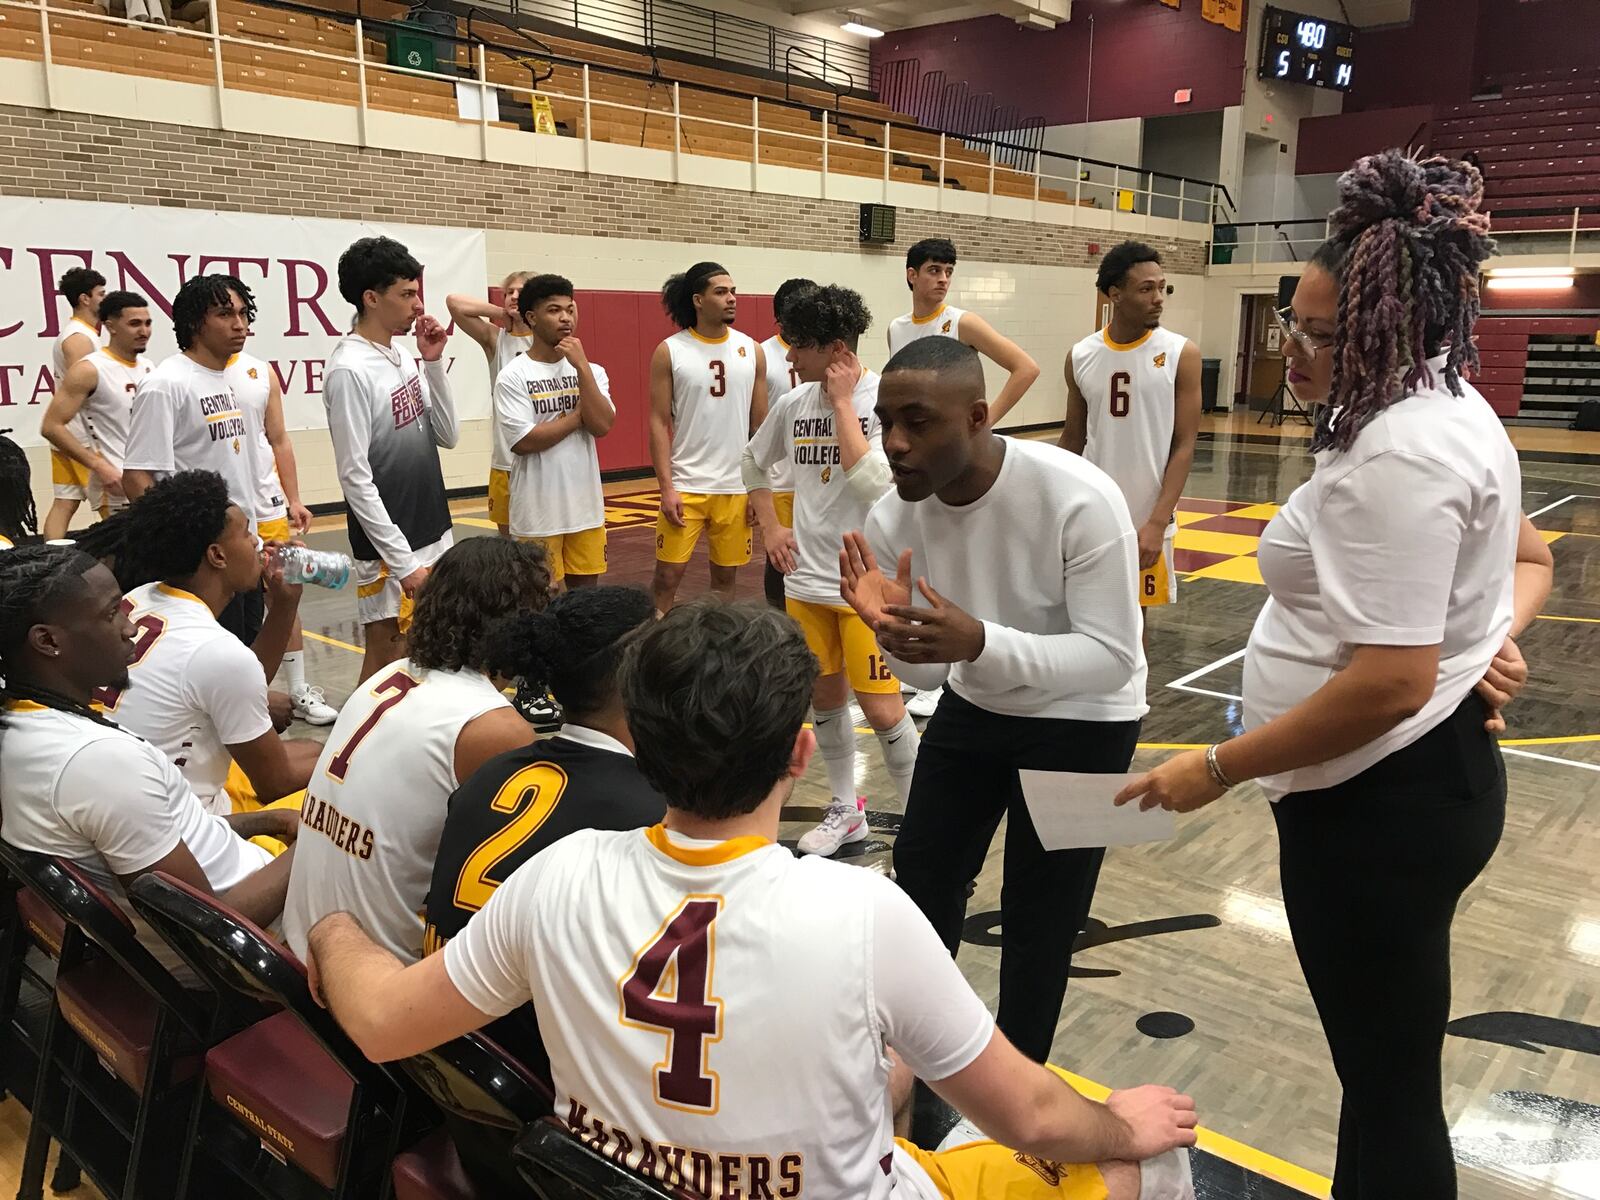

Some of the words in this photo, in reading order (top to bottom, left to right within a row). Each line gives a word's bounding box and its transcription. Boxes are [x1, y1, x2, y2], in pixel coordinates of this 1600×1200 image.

[1278, 51, 1290, 76] 5
[1307, 64, 1315, 80] 1
[1336, 64, 1352, 86] 14
[526, 378, 562, 395] CENTRAL
[709, 360, 726, 398] 3
[200, 393, 232, 416] CENTRAL
[1110, 371, 1131, 417] 6
[793, 418, 833, 437] CENTRAL
[794, 445, 841, 465] VOLLEYB
[1144, 575, 1155, 596] 6
[868, 654, 892, 680] 12
[326, 668, 422, 784] 7
[453, 761, 568, 911] 2
[617, 894, 724, 1116] 4
[227, 1094, 267, 1133] CENTRAL
[267, 1124, 295, 1153] STATE
